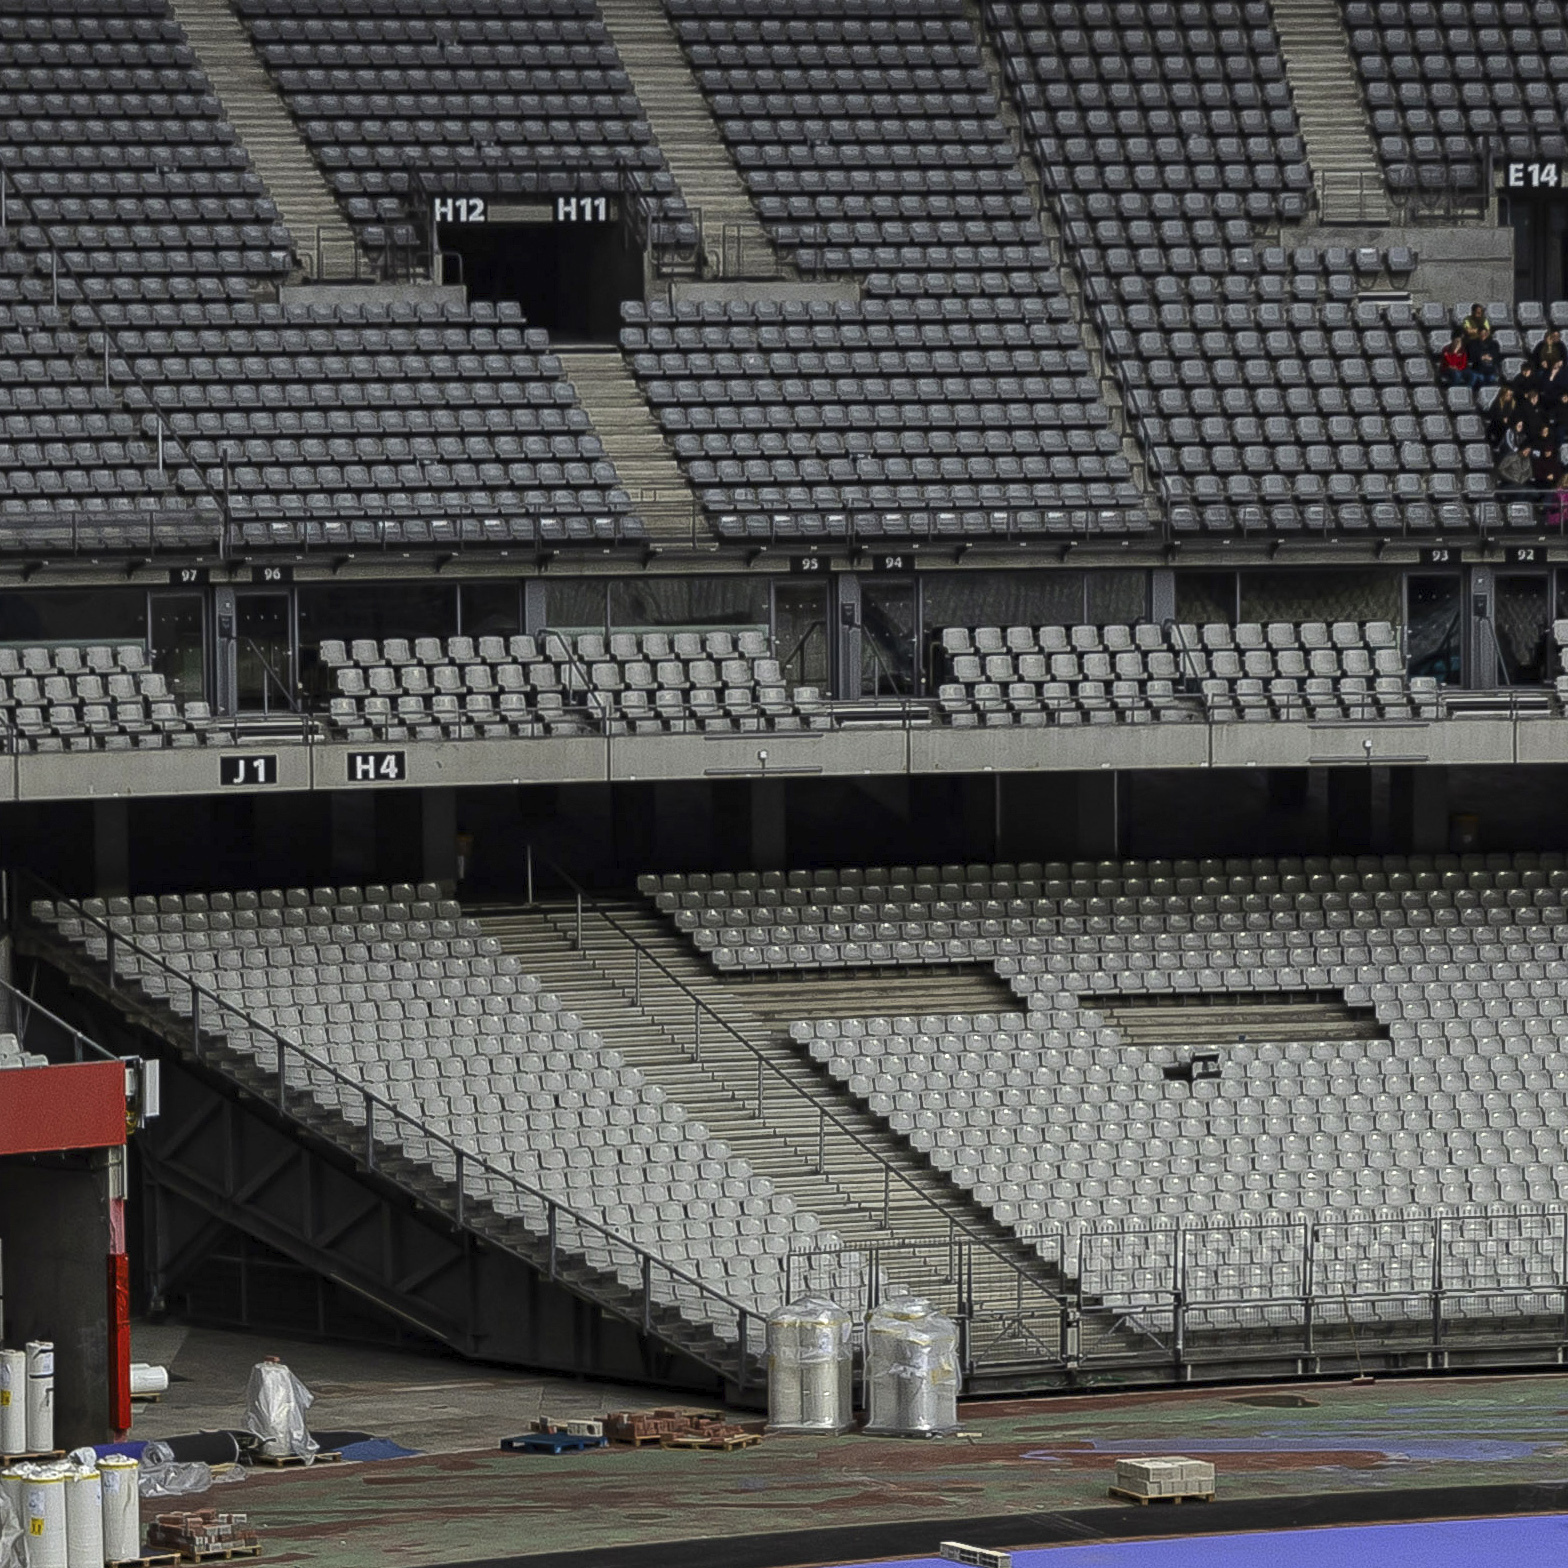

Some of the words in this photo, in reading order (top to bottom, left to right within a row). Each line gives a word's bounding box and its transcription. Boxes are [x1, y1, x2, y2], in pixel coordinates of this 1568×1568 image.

[1509, 163, 1558, 187] E14
[434, 197, 485, 222] H12
[557, 197, 606, 221] H11
[1432, 550, 1449, 561] 93
[1518, 549, 1534, 561] 92
[802, 558, 818, 570] 95
[885, 557, 902, 569] 94
[181, 569, 197, 581] 97
[264, 568, 281, 580] 96
[233, 758, 265, 783] J1
[356, 754, 398, 780] H4
